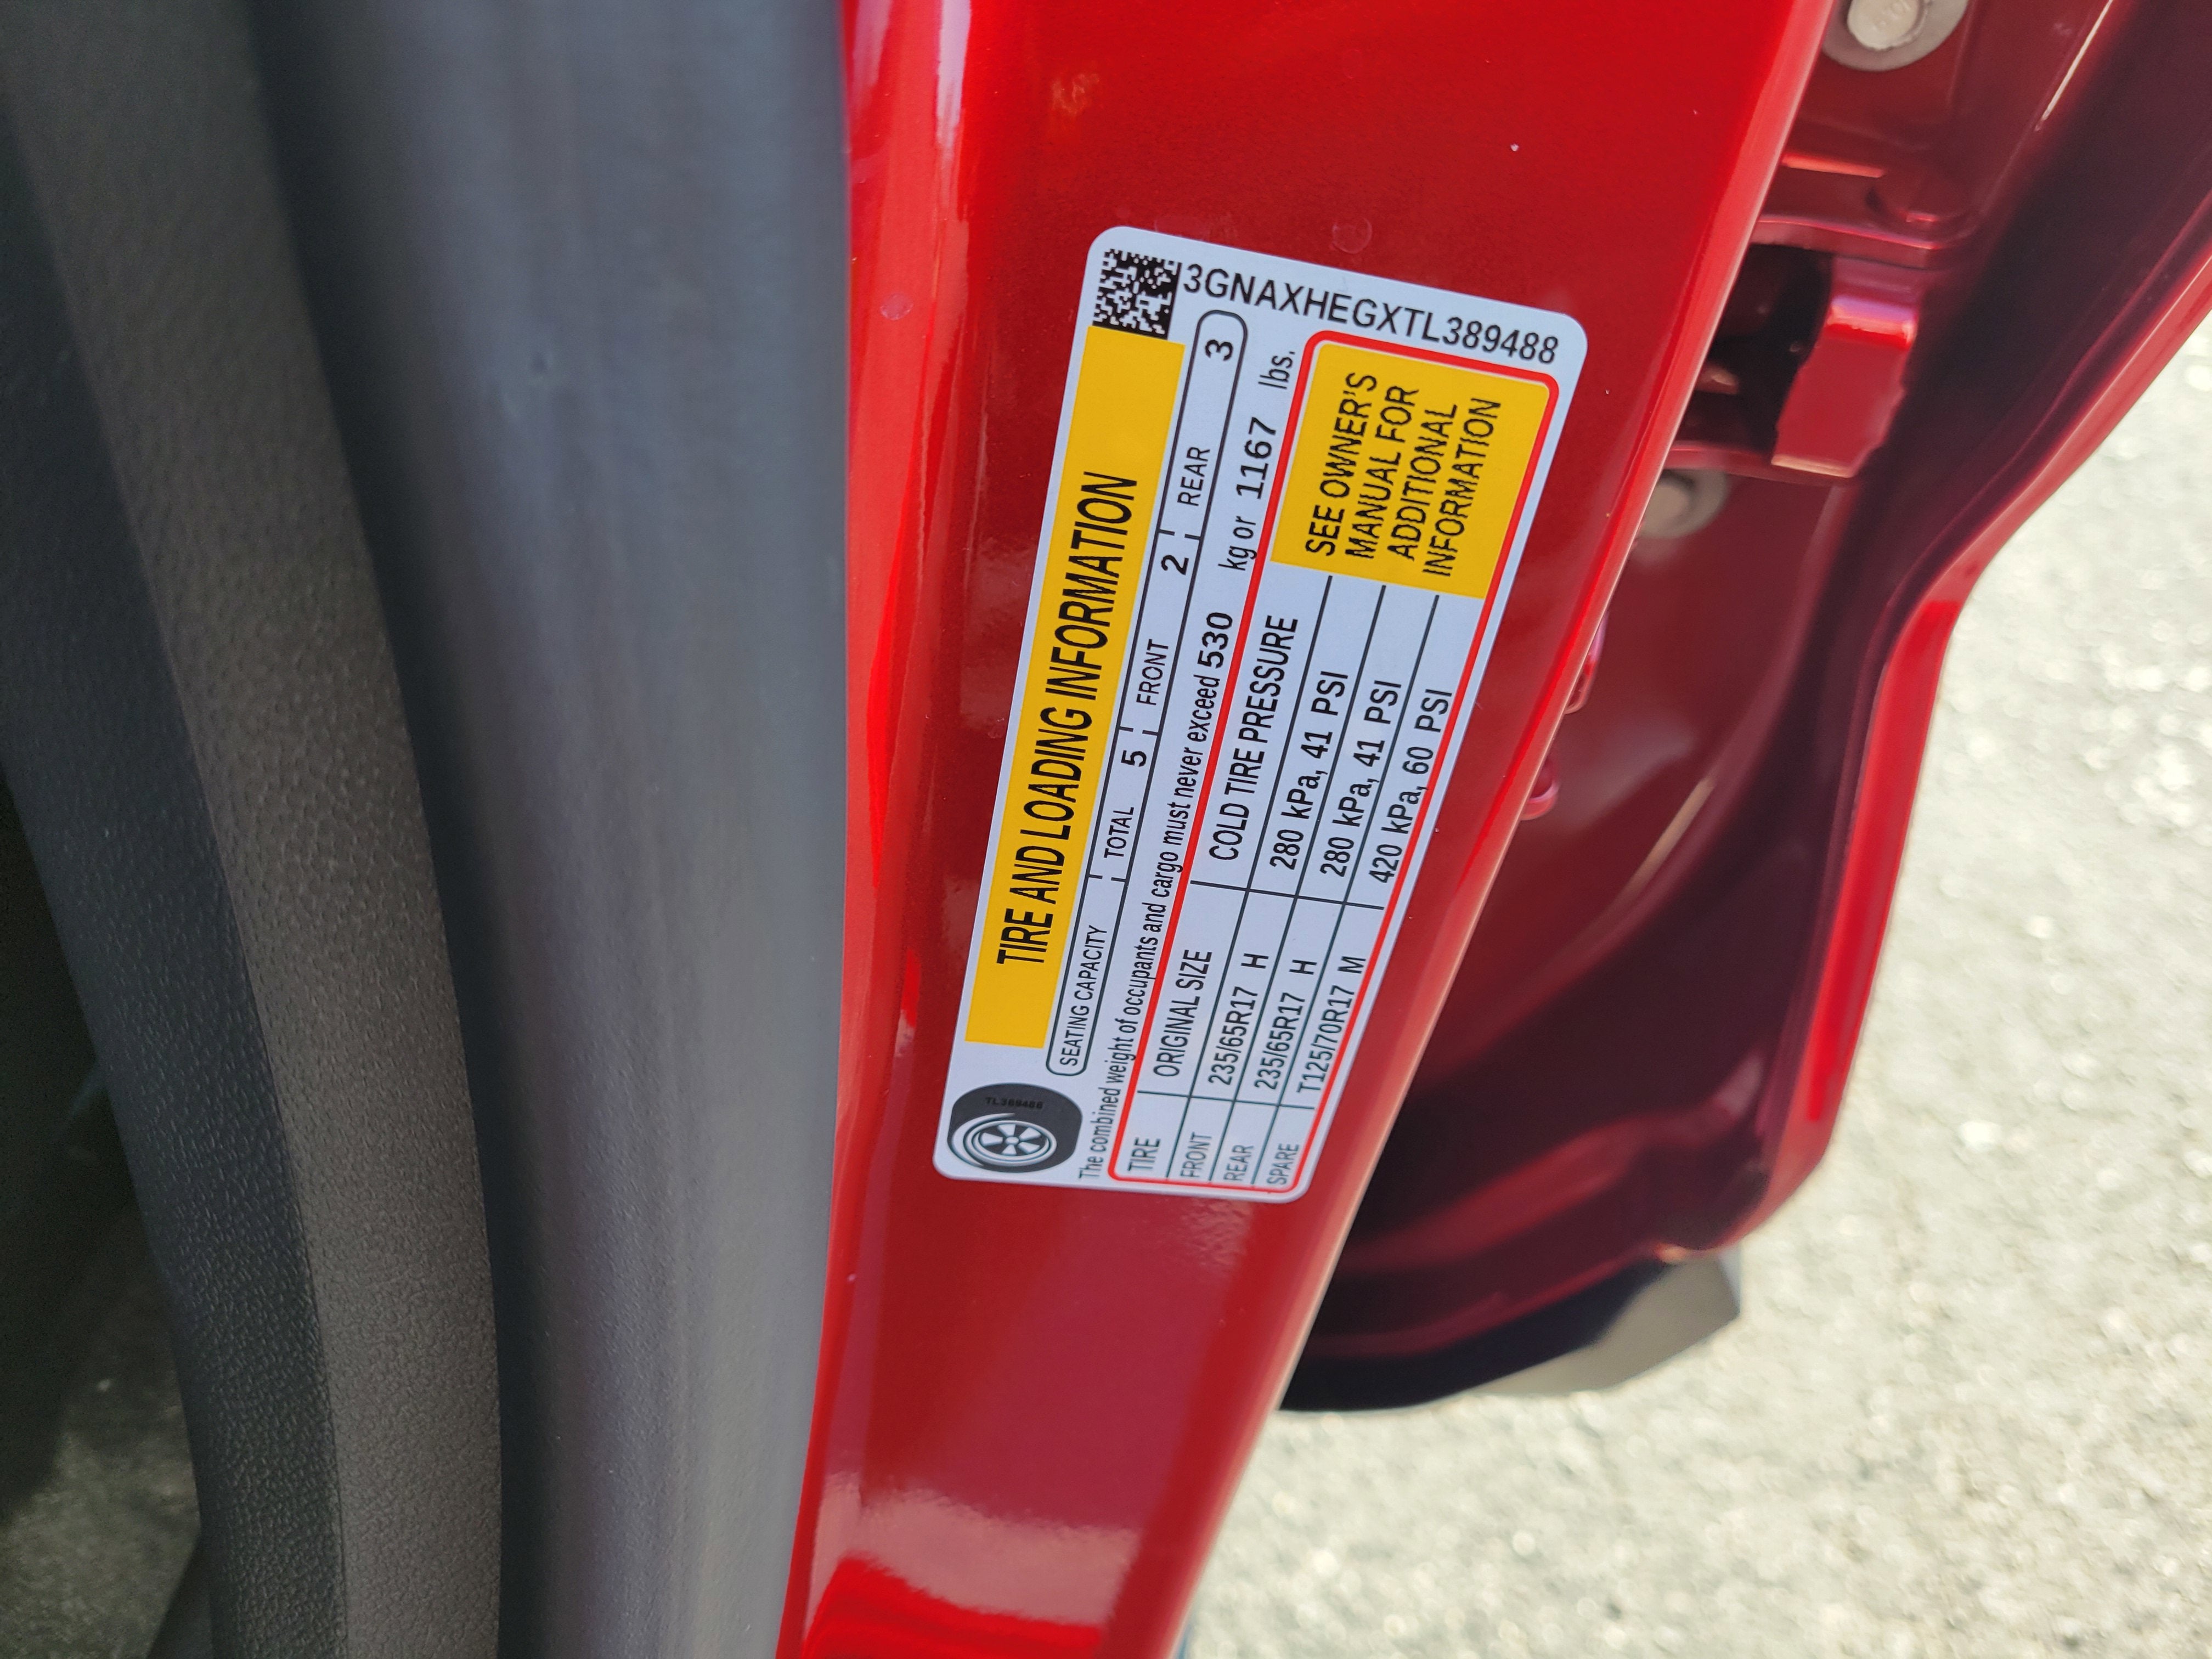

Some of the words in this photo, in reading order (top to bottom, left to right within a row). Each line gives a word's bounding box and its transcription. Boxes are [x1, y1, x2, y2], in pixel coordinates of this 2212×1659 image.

[1183, 263, 1559, 364] 3GNAXHEGXTL389488
[1258, 351, 1295, 390] lbs.
[1177, 447, 1210, 506] REAR
[1204, 339, 1234, 361] 3
[1319, 373, 1377, 498] OWNER'S
[1236, 416, 1276, 499] 1167
[1345, 452, 1401, 559] MANUAL
[1375, 386, 1419, 443] FOR
[1387, 404, 1457, 561] ADDITIONAL
[1422, 398, 1501, 577] INFORMATION
[1233, 516, 1256, 539] or
[1305, 505, 1345, 556] SEE
[1218, 545, 1256, 571] kg
[1045, 471, 1137, 701] INFORMATION
[1136, 639, 1169, 706] FRONT
[1160, 554, 1189, 575] 2
[1197, 612, 1233, 669] 530
[1238, 615, 1298, 743] PRESSURE
[1310, 671, 1348, 716] PSI
[1363, 680, 1402, 725] PSI
[1187, 674, 1221, 742] exceed
[1414, 689, 1452, 733] PSI
[1300, 731, 1333, 759] 41
[1353, 740, 1385, 768] 41
[1402, 746, 1434, 775] 60
[1020, 707, 1092, 840] LOADING
[1173, 747, 1203, 798] never
[1224, 748, 1265, 795] TIRE
[1280, 770, 1327, 820] kPa,
[1103, 806, 1135, 859] TOTAL
[1120, 750, 1147, 768] 5
[1163, 802, 1191, 846] must
[1331, 778, 1379, 827] kPa,
[1380, 786, 1428, 834] kPa,
[1209, 803, 1250, 860] COLD
[1269, 829, 1304, 870] 280
[1009, 845, 1065, 905] AND
[1151, 851, 1183, 898] cargo
[1319, 837, 1355, 877] 280
[1368, 844, 1403, 883] 420
[996, 908, 1054, 964] TIRE
[1142, 902, 1167, 933] and
[1074, 924, 1107, 1001] CAPACITY
[1123, 936, 1159, 1015] occupants
[1175, 949, 1212, 991] SIZE
[1059, 1005, 1090, 1066] SEATING
[1114, 1018, 1138, 1034] of
[1153, 996, 1200, 1077] ORIGINAL
[1207, 986, 1258, 1085] 235/65R17
[1240, 953, 1269, 969] H
[1254, 992, 1305, 1090] 235/65R17
[1289, 960, 1317, 975] H
[1296, 985, 1355, 1093] T125/70R17
[1337, 956, 1366, 974] M
[1105, 1036, 1136, 1084] weight
[1090, 1087, 1121, 1153] combined
[1078, 1156, 1104, 1179] The
[1127, 1138, 1160, 1171] TIRE
[1180, 1131, 1212, 1177] FRONT
[1223, 1145, 1254, 1181] REAR
[1266, 1143, 1299, 1185] SPARE
